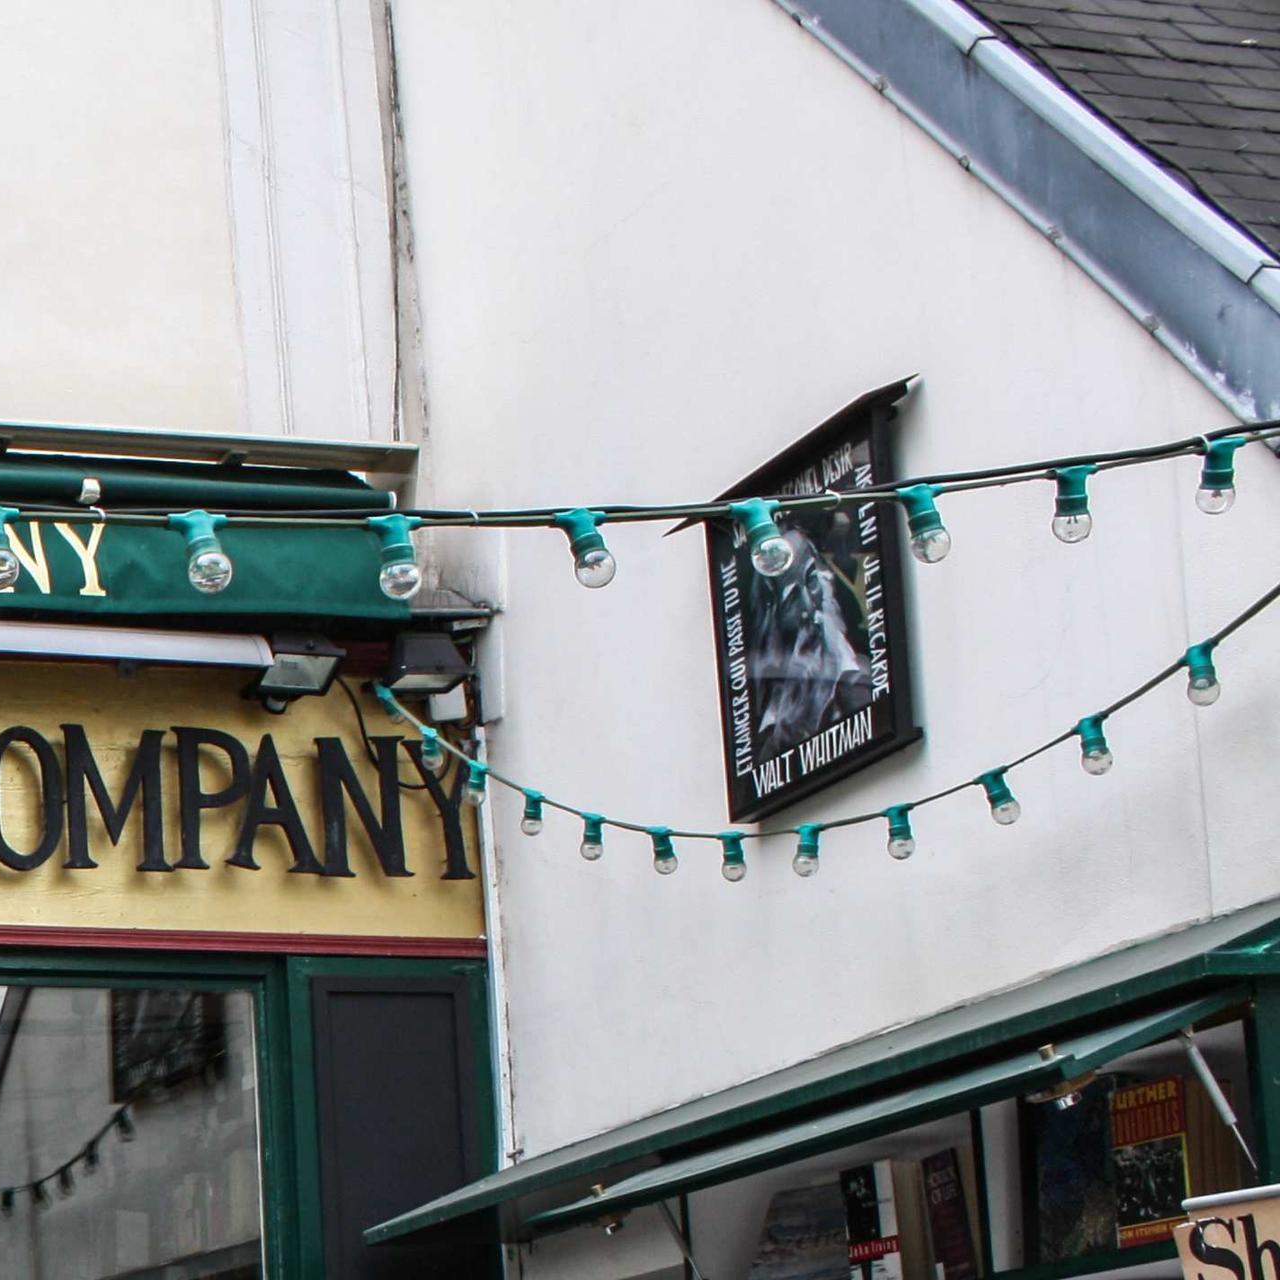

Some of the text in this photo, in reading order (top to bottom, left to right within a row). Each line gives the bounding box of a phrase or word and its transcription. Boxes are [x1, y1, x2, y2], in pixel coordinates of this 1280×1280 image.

[724, 588, 740, 613] TU
[729, 655, 746, 690] QUI
[752, 705, 872, 798] WALT WHITMAN
